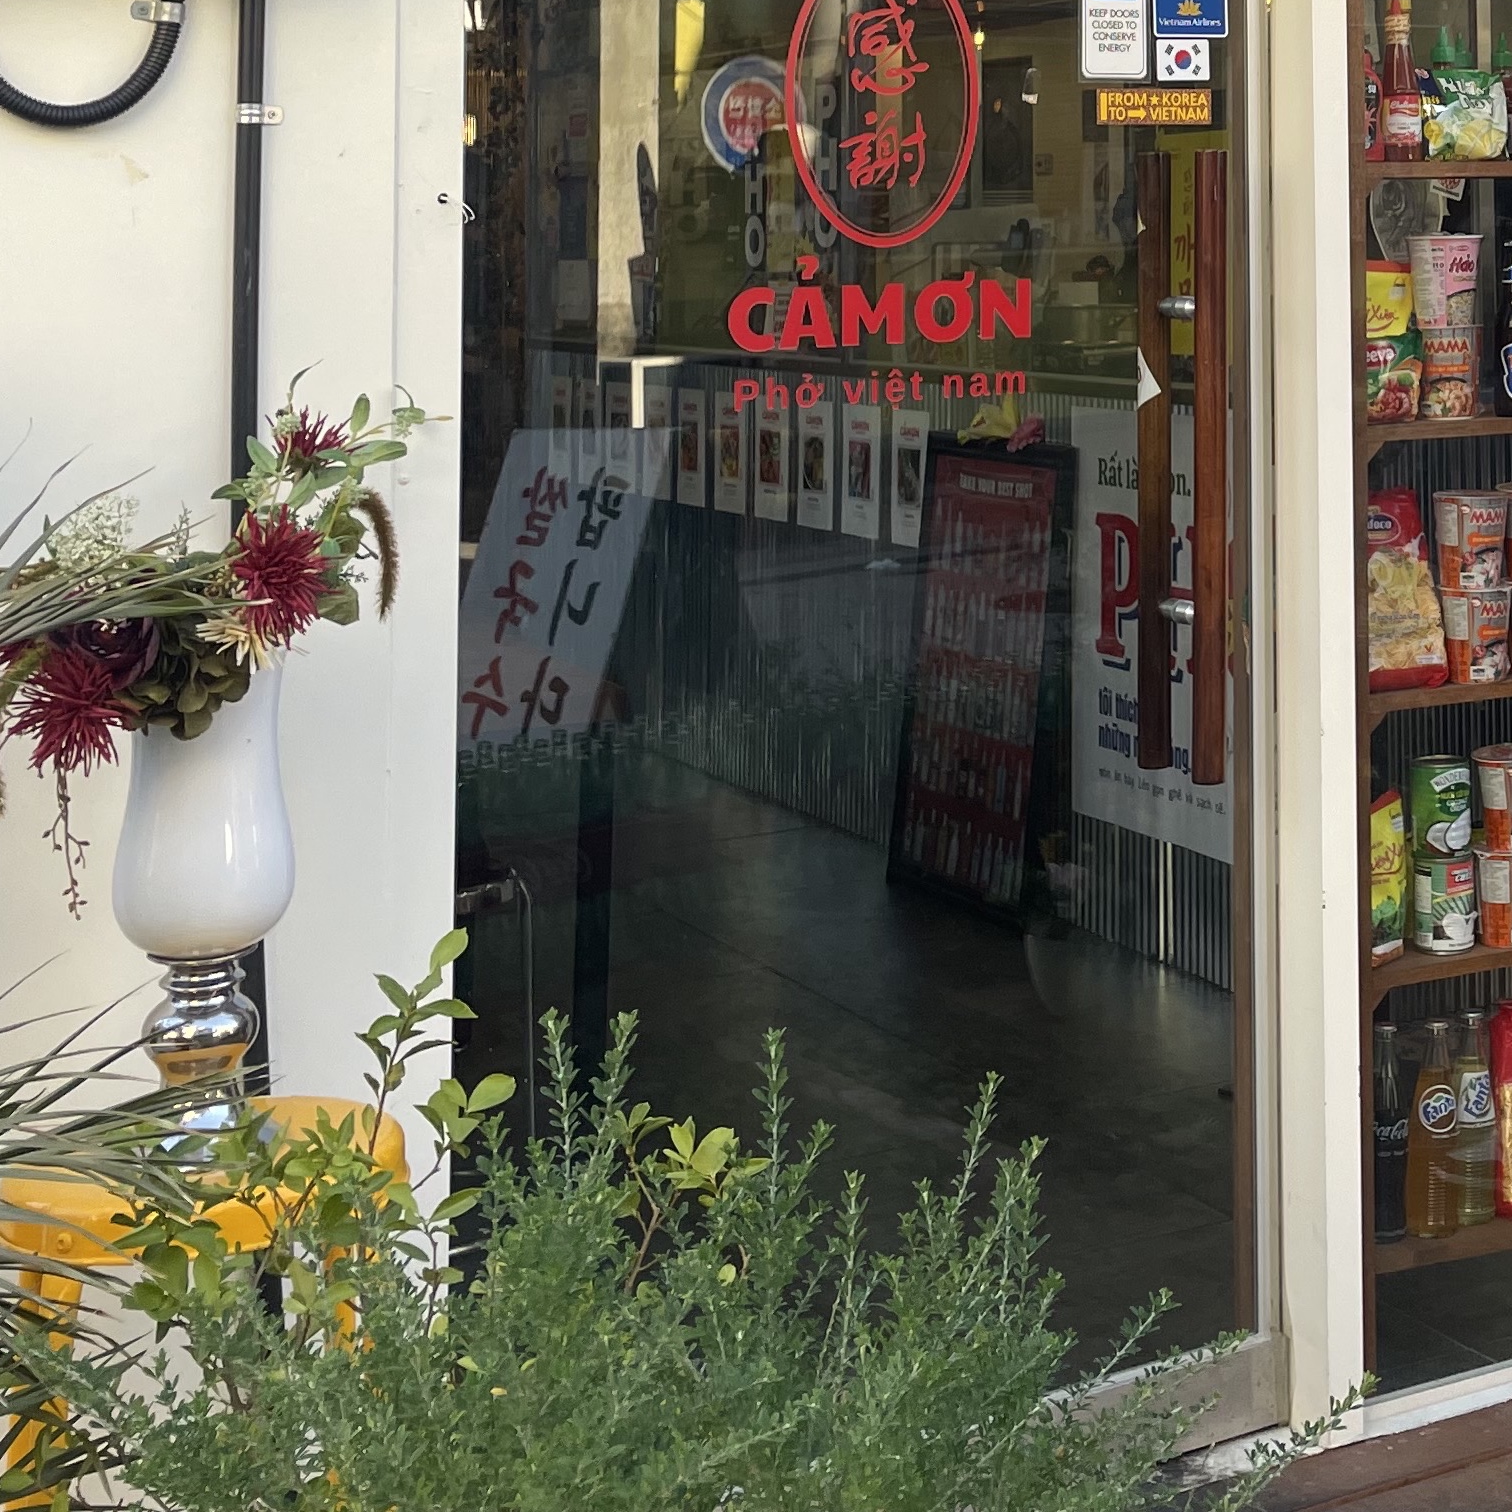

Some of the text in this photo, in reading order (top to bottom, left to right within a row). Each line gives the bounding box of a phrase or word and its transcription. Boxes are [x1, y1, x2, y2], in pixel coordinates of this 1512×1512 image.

[1089, 9, 1139, 18] KEEP DOORS
[1091, 20, 1138, 30] CLOSED TO
[1092, 32, 1137, 41] CONSERVE
[1098, 43, 1131, 53] ENERGY
[1107, 93, 1208, 106] FROM KOREA
[1108, 106, 1208, 121] TO VIETNAM
[727, 255, 1033, 353] CẢMƠN
[1424, 339, 1470, 354] MAMA
[1366, 347, 1397, 364] eeva
[733, 369, 1028, 413] Phở việt nam
[1098, 451, 1122, 488] Rất
[1015, 482, 1033, 499] SHOT
